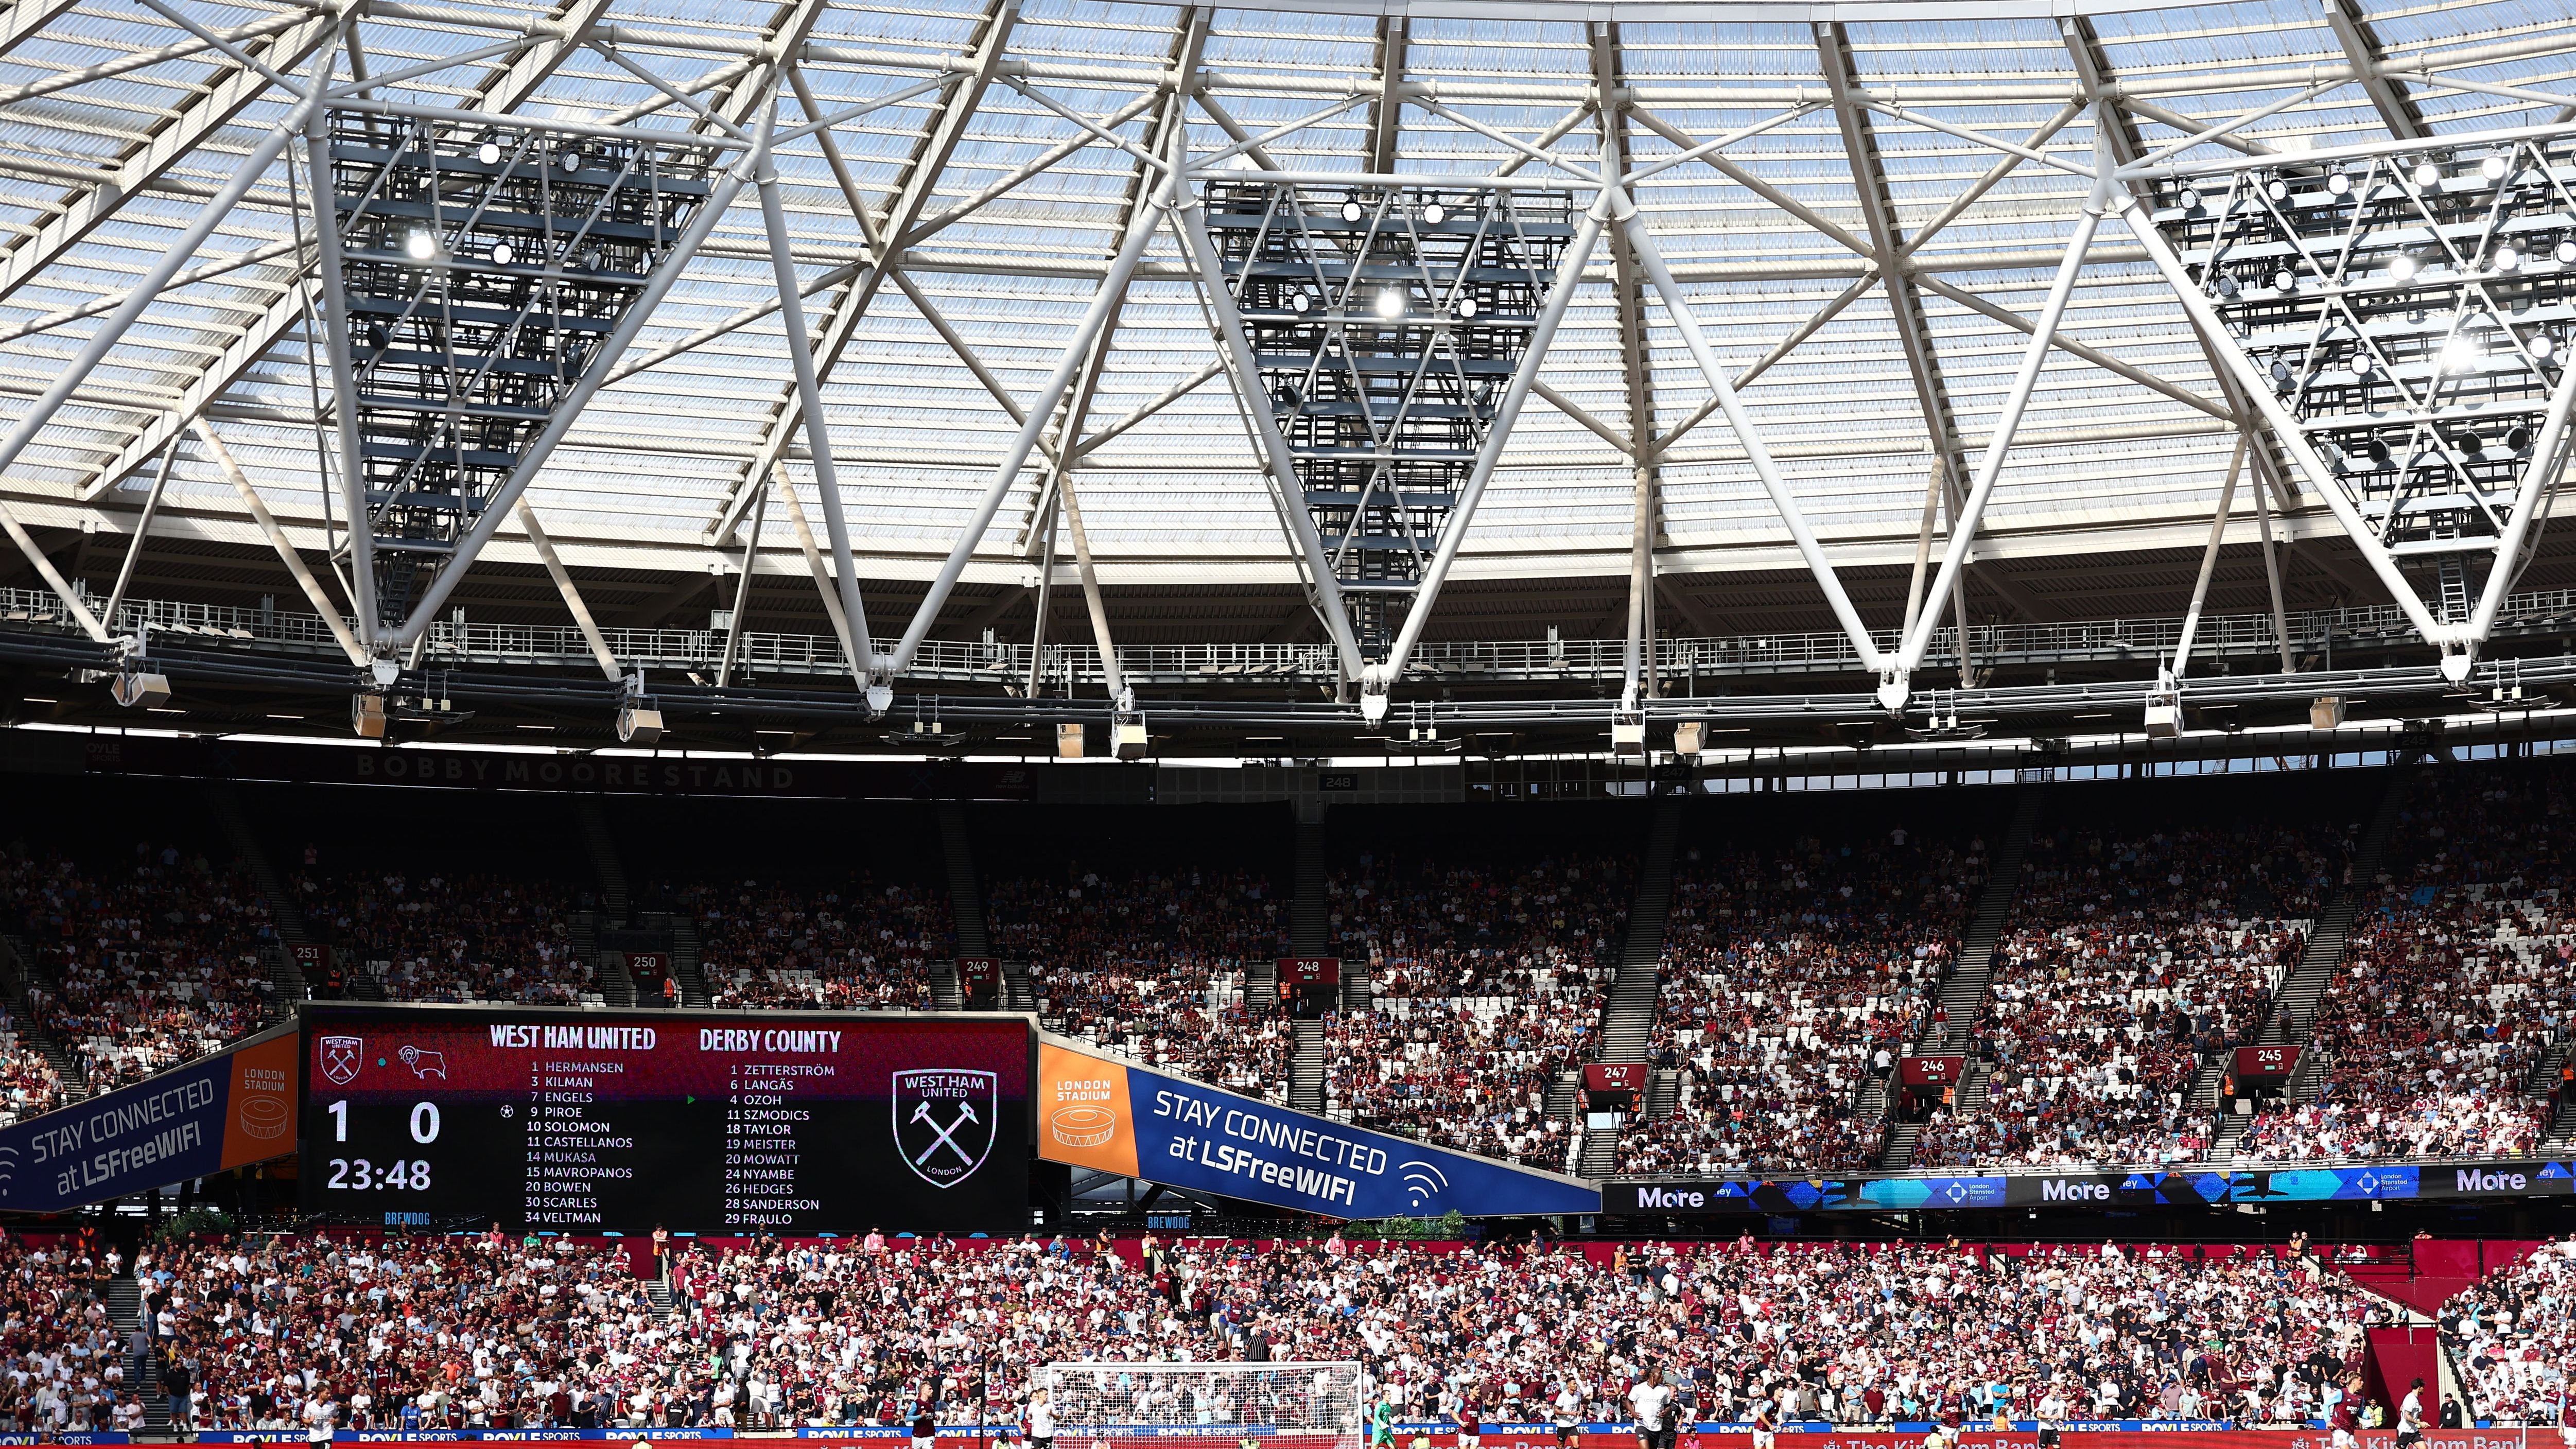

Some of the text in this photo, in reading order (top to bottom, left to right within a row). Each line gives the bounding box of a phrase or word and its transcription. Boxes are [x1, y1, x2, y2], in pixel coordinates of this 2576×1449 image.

[86, 743, 119, 754] OYLE
[2028, 755, 2053, 765] 246
[357, 754, 793, 789] BOBBY MOORE STAND
[1662, 768, 1685, 777] 247
[1326, 778, 1351, 787] 248
[297, 948, 319, 958] 251
[634, 957, 656, 967] 250
[967, 962, 988, 971] 249
[1297, 962, 1319, 972] 248
[491, 1025, 655, 1050] WEST HAM UNITED
[701, 1029, 841, 1052] DERBY COUNTY
[2258, 1050, 2282, 1061] 245
[532, 1061, 623, 1072] 1 HERMANSEN
[732, 1065, 834, 1076] 1 ZETTERSTRÖM
[1921, 1060, 1944, 1072] 246
[245, 1068, 285, 1080] LONDON
[1605, 1067, 1628, 1078] 247
[245, 1079, 285, 1091] STADIUM
[532, 1077, 592, 1087] 3 KILMAN
[731, 1080, 738, 1089] 6
[905, 1076, 984, 1090] WEST HAM
[1057, 1080, 1110, 1091] LONDON
[532, 1092, 592, 1102] 7 ENGELS
[922, 1088, 968, 1097] UNITED
[1057, 1090, 1110, 1101] STADIUM
[730, 1095, 781, 1105] 4 OZOH
[531, 1107, 582, 1117] 9 PIROE
[727, 1110, 809, 1120] 11 SZMODICS
[32, 1078, 214, 1163] STAY CONNECTED
[329, 1101, 346, 1141] 1
[410, 1102, 440, 1143] 0
[527, 1122, 609, 1132] 10 SOLOMON
[727, 1124, 791, 1134] 18 TAYLOR
[1153, 1090, 1387, 1176] STAY CONNECTED
[528, 1137, 632, 1147] 11 CASTELLANOS
[726, 1139, 795, 1149] 19 MEISTER
[57, 1121, 201, 1196] at LSFreeWIFI
[527, 1152, 596, 1162] 14 MUKASA
[726, 1154, 797, 1164] 20 MOWATT
[328, 1159, 430, 1190] 23:48
[527, 1167, 632, 1178] 15 MAVROPANOS
[726, 1169, 794, 1179] 24 NYAMBE
[927, 1166, 962, 1175] LONDON
[1169, 1134, 1355, 1206] at LSFreeWIFI
[2457, 1169, 2526, 1191] More
[526, 1182, 590, 1192] 20 BOWEN
[726, 1184, 793, 1194] 26 HEDGES
[2042, 1180, 2110, 1201] More
[526, 1197, 597, 1208] 30 SCARLES
[1638, 1187, 1704, 1208] More
[725, 1199, 819, 1210] 28 SANDERSON
[385, 1212, 430, 1225] BREWDOG
[526, 1212, 600, 1223] 34 VELTMAN
[725, 1214, 792, 1226] 29 FRAULO
[1147, 1215, 1190, 1229] BREWDOG
[2191, 1423, 2222, 1431] SPORTS
[419, 1433, 457, 1441] SPORTS
[664, 1431, 701, 1440] SPORTS
